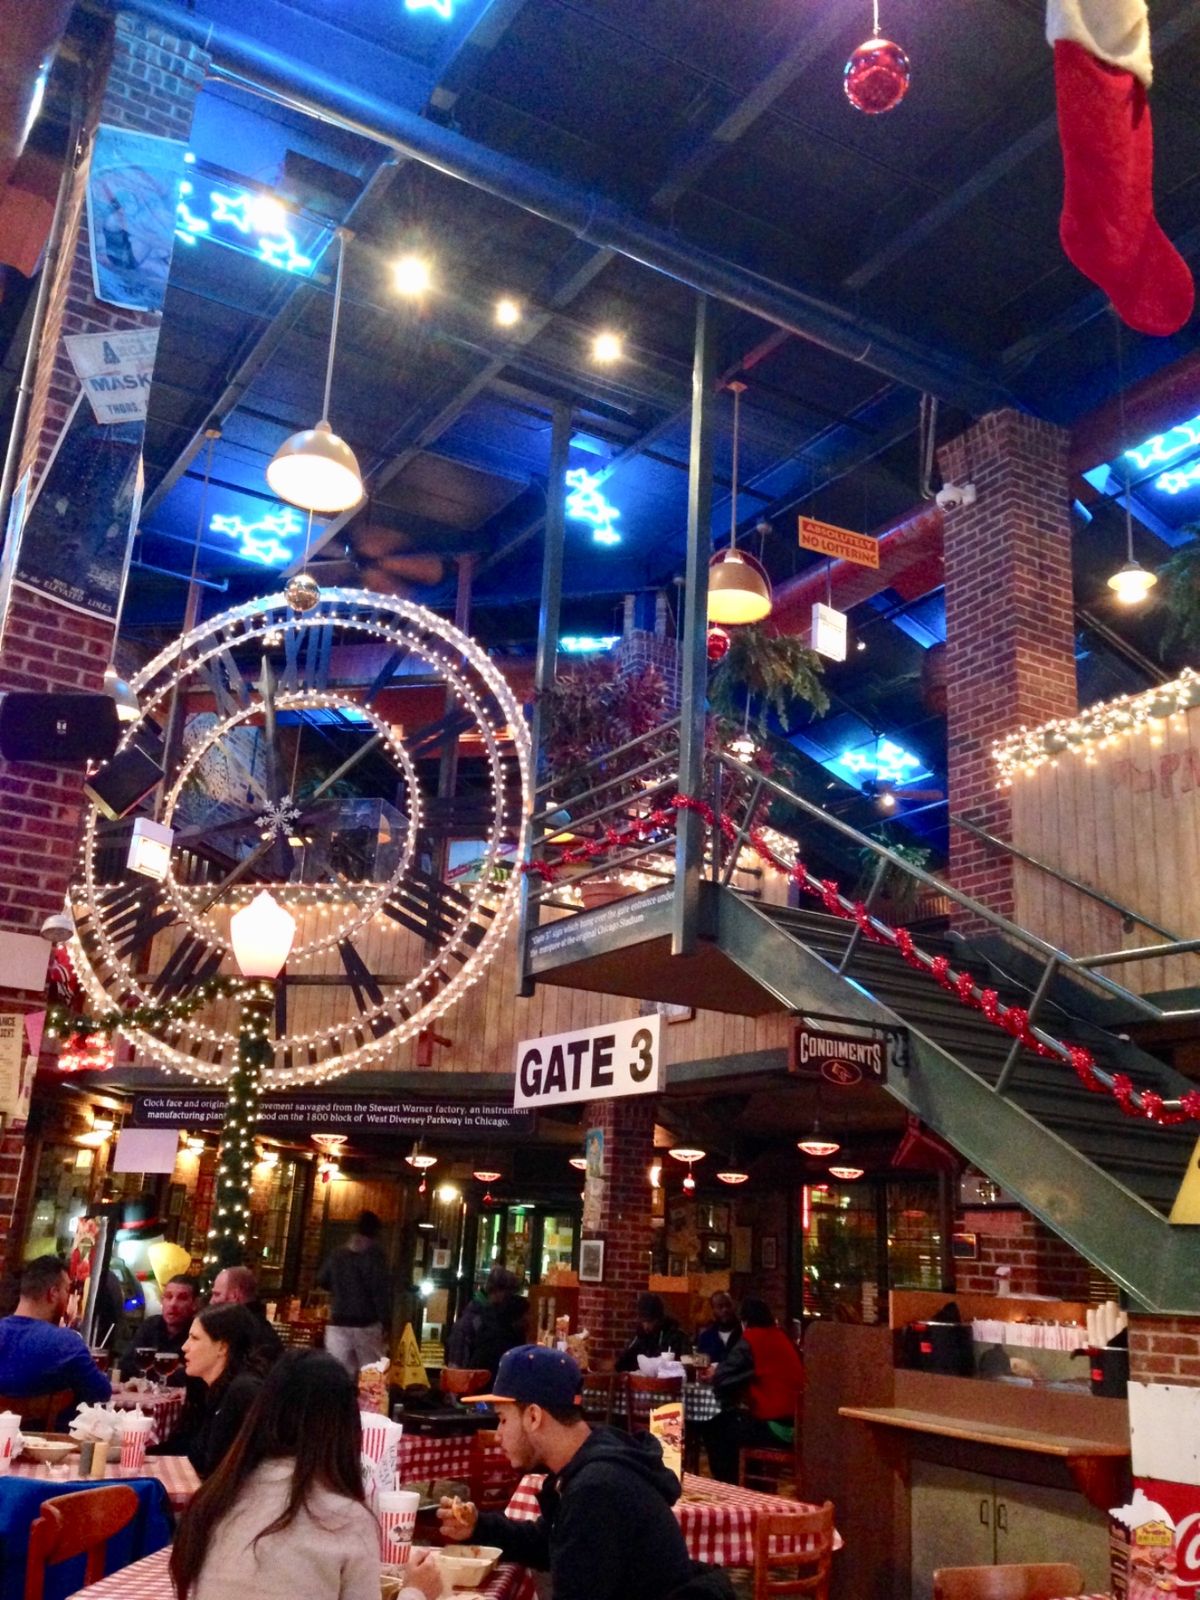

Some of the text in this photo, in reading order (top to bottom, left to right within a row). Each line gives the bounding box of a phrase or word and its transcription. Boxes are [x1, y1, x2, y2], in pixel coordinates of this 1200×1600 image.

[89, 373, 151, 391] MASK
[802, 532, 876, 564] NO LOITERING
[805, 523, 873, 549] ABSOLUTELY
[43, 580, 84, 602] ELEVATED
[88, 599, 113, 613] LINES
[631, 898, 657, 909] entrance
[575, 930, 596, 943] original
[597, 921, 619, 935] Chicago
[620, 914, 644, 926] Stadium
[520, 1028, 653, 1098] GATE 3
[800, 1032, 881, 1075] CONDIMENTS
[143, 1099, 164, 1107] Clock
[166, 1099, 182, 1108] face
[184, 1100, 199, 1108] and
[201, 1100, 230, 1110] origina
[332, 1103, 352, 1112] from
[354, 1103, 367, 1112] the
[369, 1104, 400, 1112] Stewart
[402, 1104, 433, 1113] Warner
[469, 1106, 480, 1114] an
[147, 1111, 205, 1121] manufacturing
[278, 1113, 289, 1121] on
[291, 1112, 303, 1121] the
[305, 1113, 328, 1121] 1800
[330, 1113, 352, 1122] block
[354, 1114, 363, 1122] of
[367, 1114, 388, 1123] West
[389, 1114, 425, 1125] Diversey
[427, 1116, 462, 1126] Parkway
[464, 1116, 473, 1124] in
[474, 1116, 511, 1128] Chicago.
